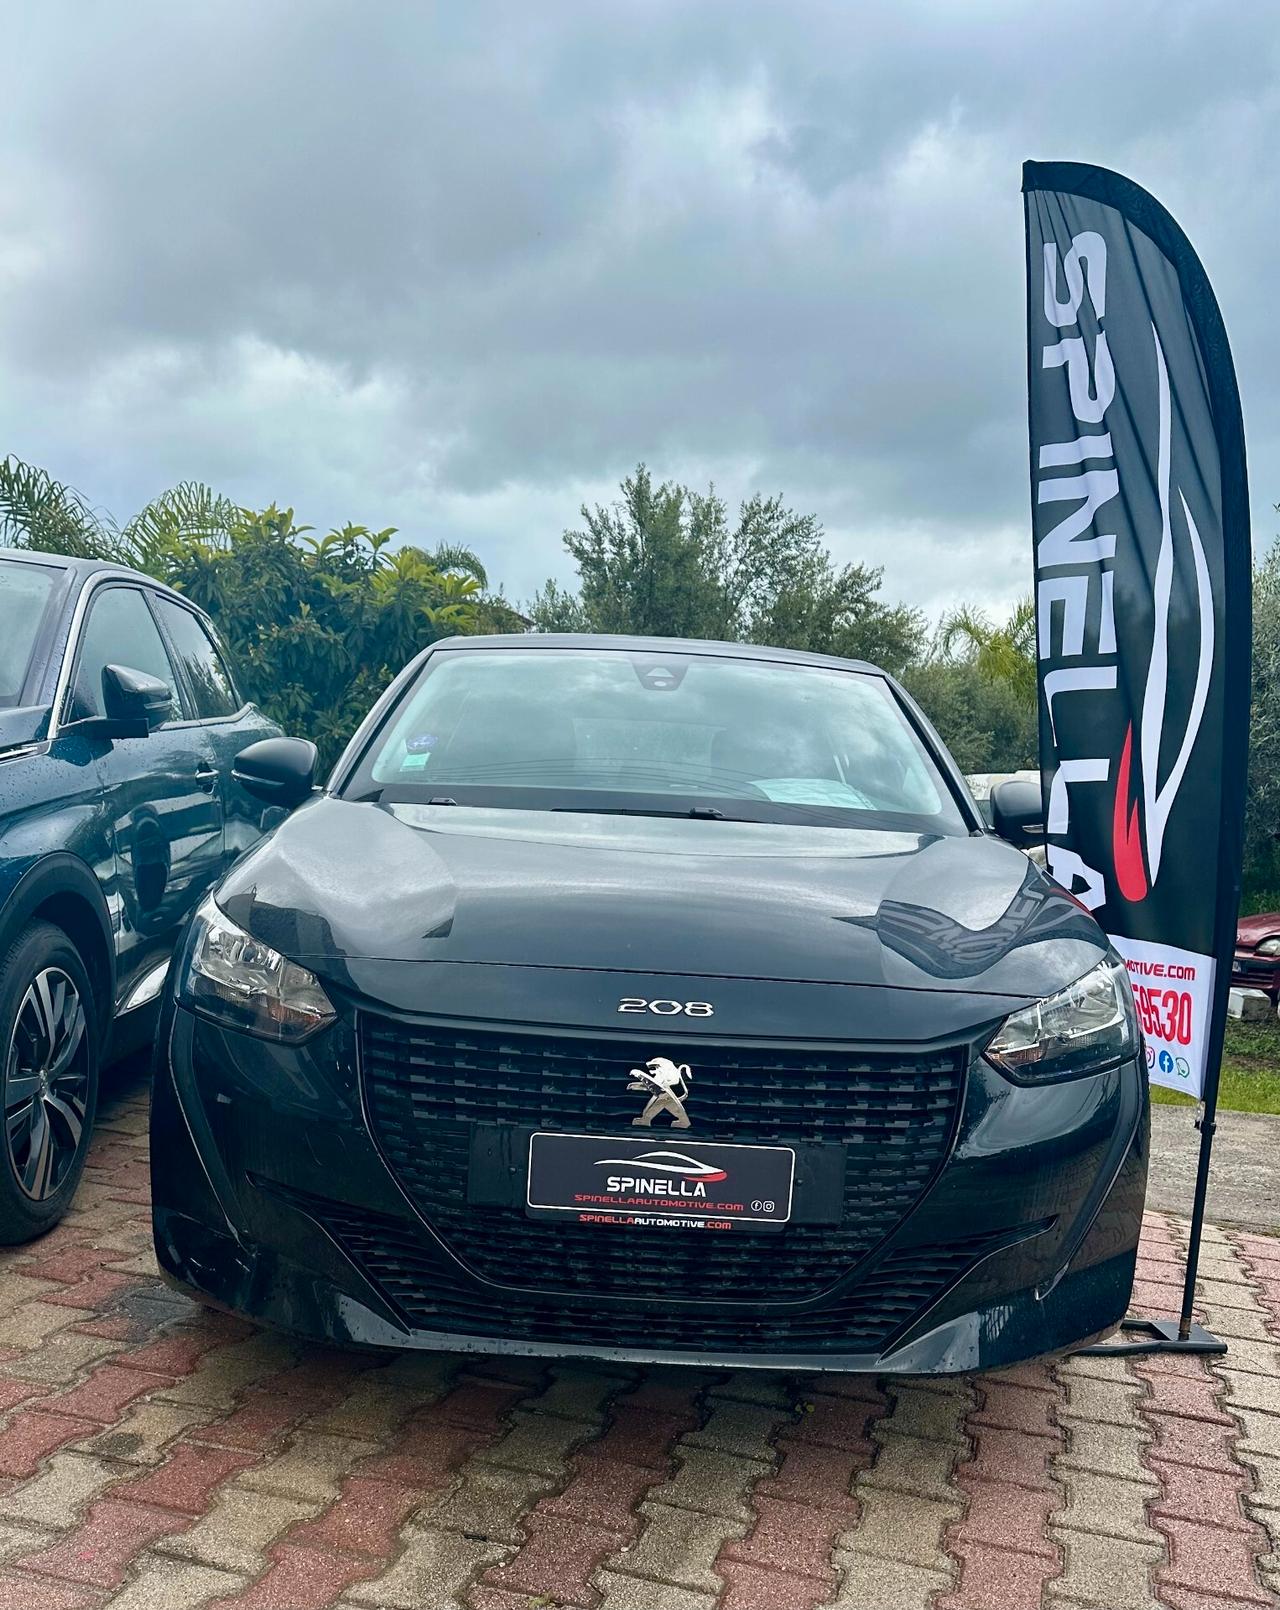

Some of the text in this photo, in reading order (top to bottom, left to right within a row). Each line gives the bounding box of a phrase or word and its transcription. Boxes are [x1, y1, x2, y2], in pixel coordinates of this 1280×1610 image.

[1039, 230, 1119, 912] SPINELLA
[617, 997, 714, 1017] 208
[606, 1176, 707, 1198] SPINELLA
